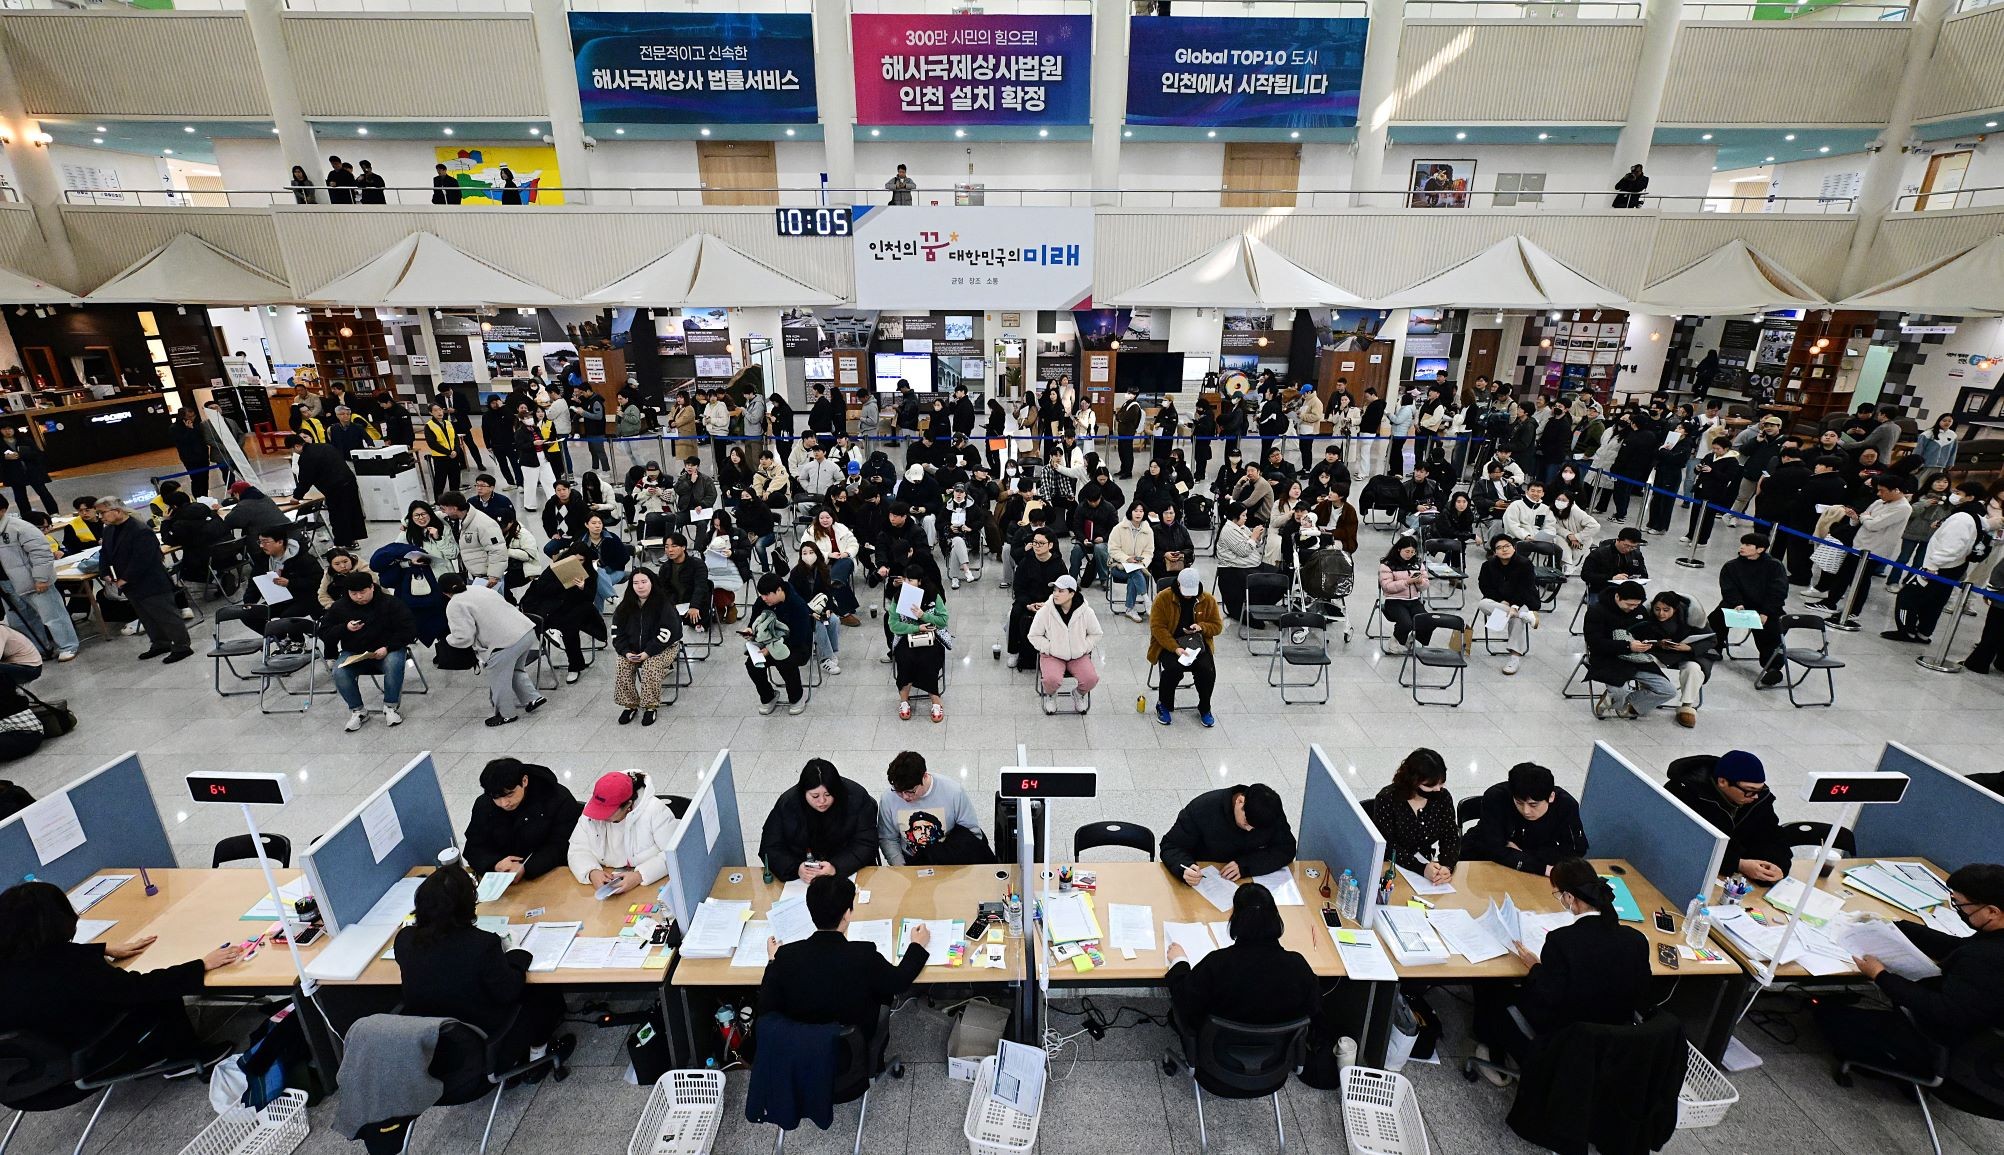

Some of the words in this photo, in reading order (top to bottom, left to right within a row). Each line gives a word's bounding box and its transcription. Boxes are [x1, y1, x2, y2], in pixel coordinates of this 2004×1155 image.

[905, 29, 948, 46] 300만
[951, 30, 991, 46] 시민의
[994, 30, 1038, 46] 힘으로!
[639, 45, 706, 61] 전문적이고
[708, 45, 748, 61] 신속한
[1175, 48, 1228, 65] Global
[1231, 49, 1287, 66] TOP10
[1290, 50, 1319, 66] 도시
[880, 54, 1063, 81] 해사국제상사법원
[592, 68, 704, 91] 해사국제상사
[707, 69, 800, 91] 법률서비스
[1161, 72, 1234, 95] 인천에서
[1237, 73, 1329, 95] 시작됩니다
[899, 85, 945, 112] 인천
[949, 85, 996, 112] 설치
[1001, 85, 1046, 112] 확정
[778, 208, 849, 235] 10:05
[869, 239, 918, 262] 인천의
[919, 231, 950, 262] 꿈
[949, 247, 1021, 268] 대한민국의
[1023, 243, 1080, 267] 미래
[209, 784, 226, 795] 64
[1021, 779, 1038, 790] 64
[1830, 784, 1849, 795] 64
